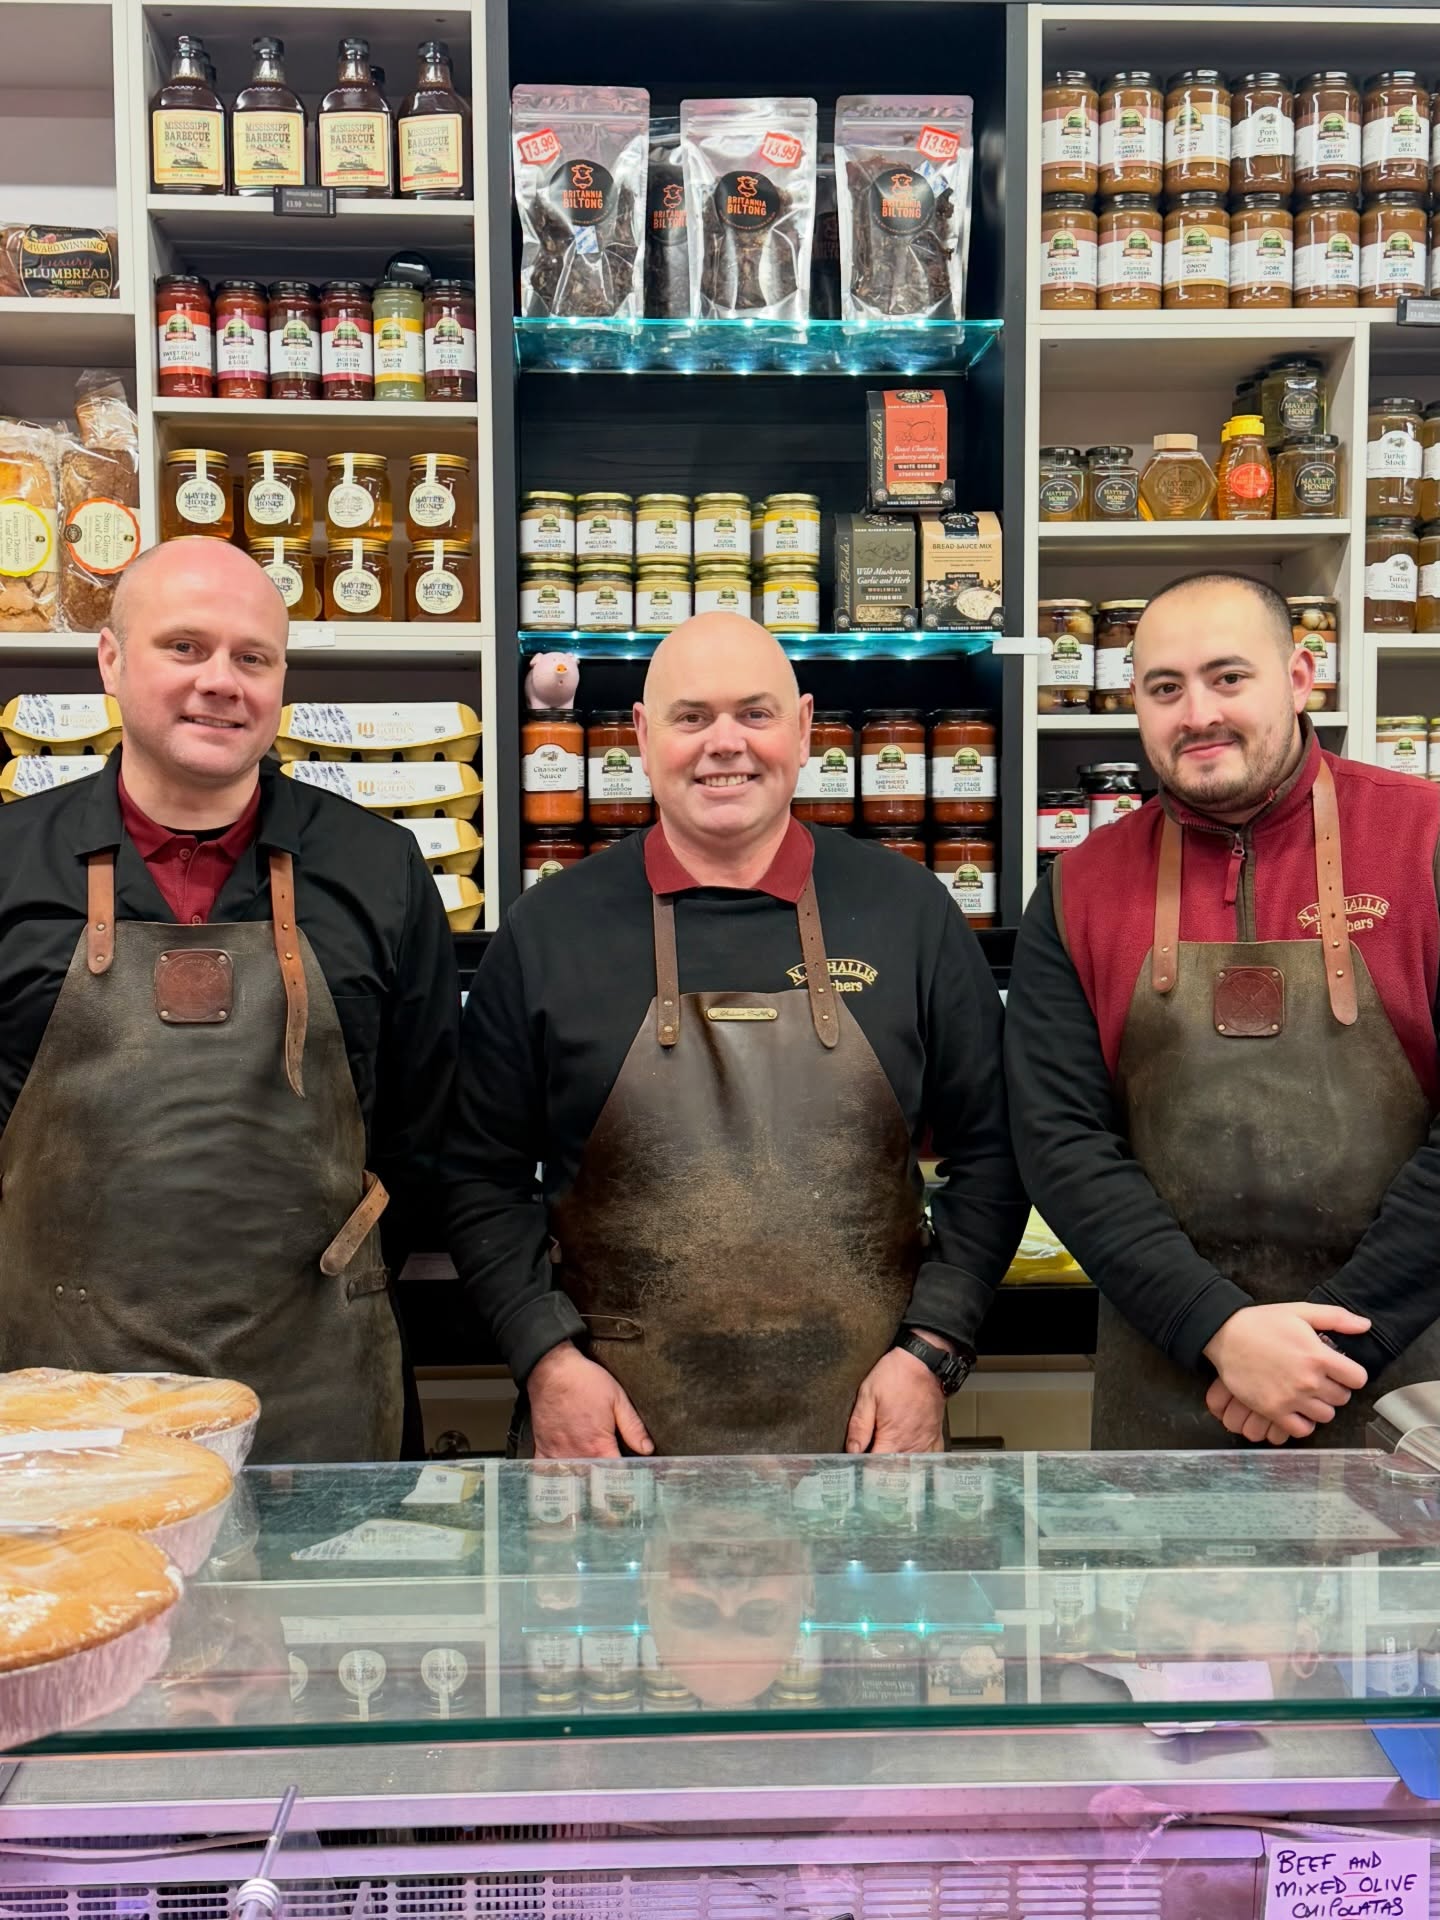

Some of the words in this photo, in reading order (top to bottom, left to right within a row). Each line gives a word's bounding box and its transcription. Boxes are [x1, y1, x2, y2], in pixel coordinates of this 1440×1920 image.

[164, 121, 210, 130] MISSISSIPPI
[246, 123, 290, 131] MISSISSIPPI
[330, 123, 374, 133] MISSISSIPPI
[165, 131, 210, 141] BARBECUE
[408, 126, 449, 137] MISSISSIPPI
[246, 132, 290, 143] BARBECUE
[331, 134, 375, 144] BARBECUE
[408, 136, 449, 149] BARBECUE
[526, 135, 555, 159] 13.99
[765, 139, 797, 159] 13.99
[923, 133, 955, 155] 13.99
[562, 190, 603, 199] BRITANNIA
[562, 199, 603, 209] BILTONG
[727, 196, 766, 207] BRITANNIA
[882, 199, 921, 209] BRITANNIA
[727, 204, 766, 216] BILTONG
[882, 207, 922, 218] BILTONG
[29, 242, 60, 253] AWARD
[62, 239, 103, 251] WINNING
[38, 256, 95, 268] Luxury
[24, 268, 109, 279] PLUMBREAD
[184, 491, 217, 501] MAYTREE
[856, 567, 873, 576] Wild
[873, 567, 912, 576] Mushroom,
[857, 576, 878, 585] Garlic
[879, 576, 893, 584] and
[893, 576, 911, 585] Herb
[357, 721, 375, 734] 10
[358, 780, 375, 792] 10
[1277, 1850, 1336, 1875] BEEF
[1349, 1850, 1382, 1870] AND
[1359, 1874, 1418, 1893] OLIVE
[1292, 1897, 1404, 1919] CHIPOLATAS
